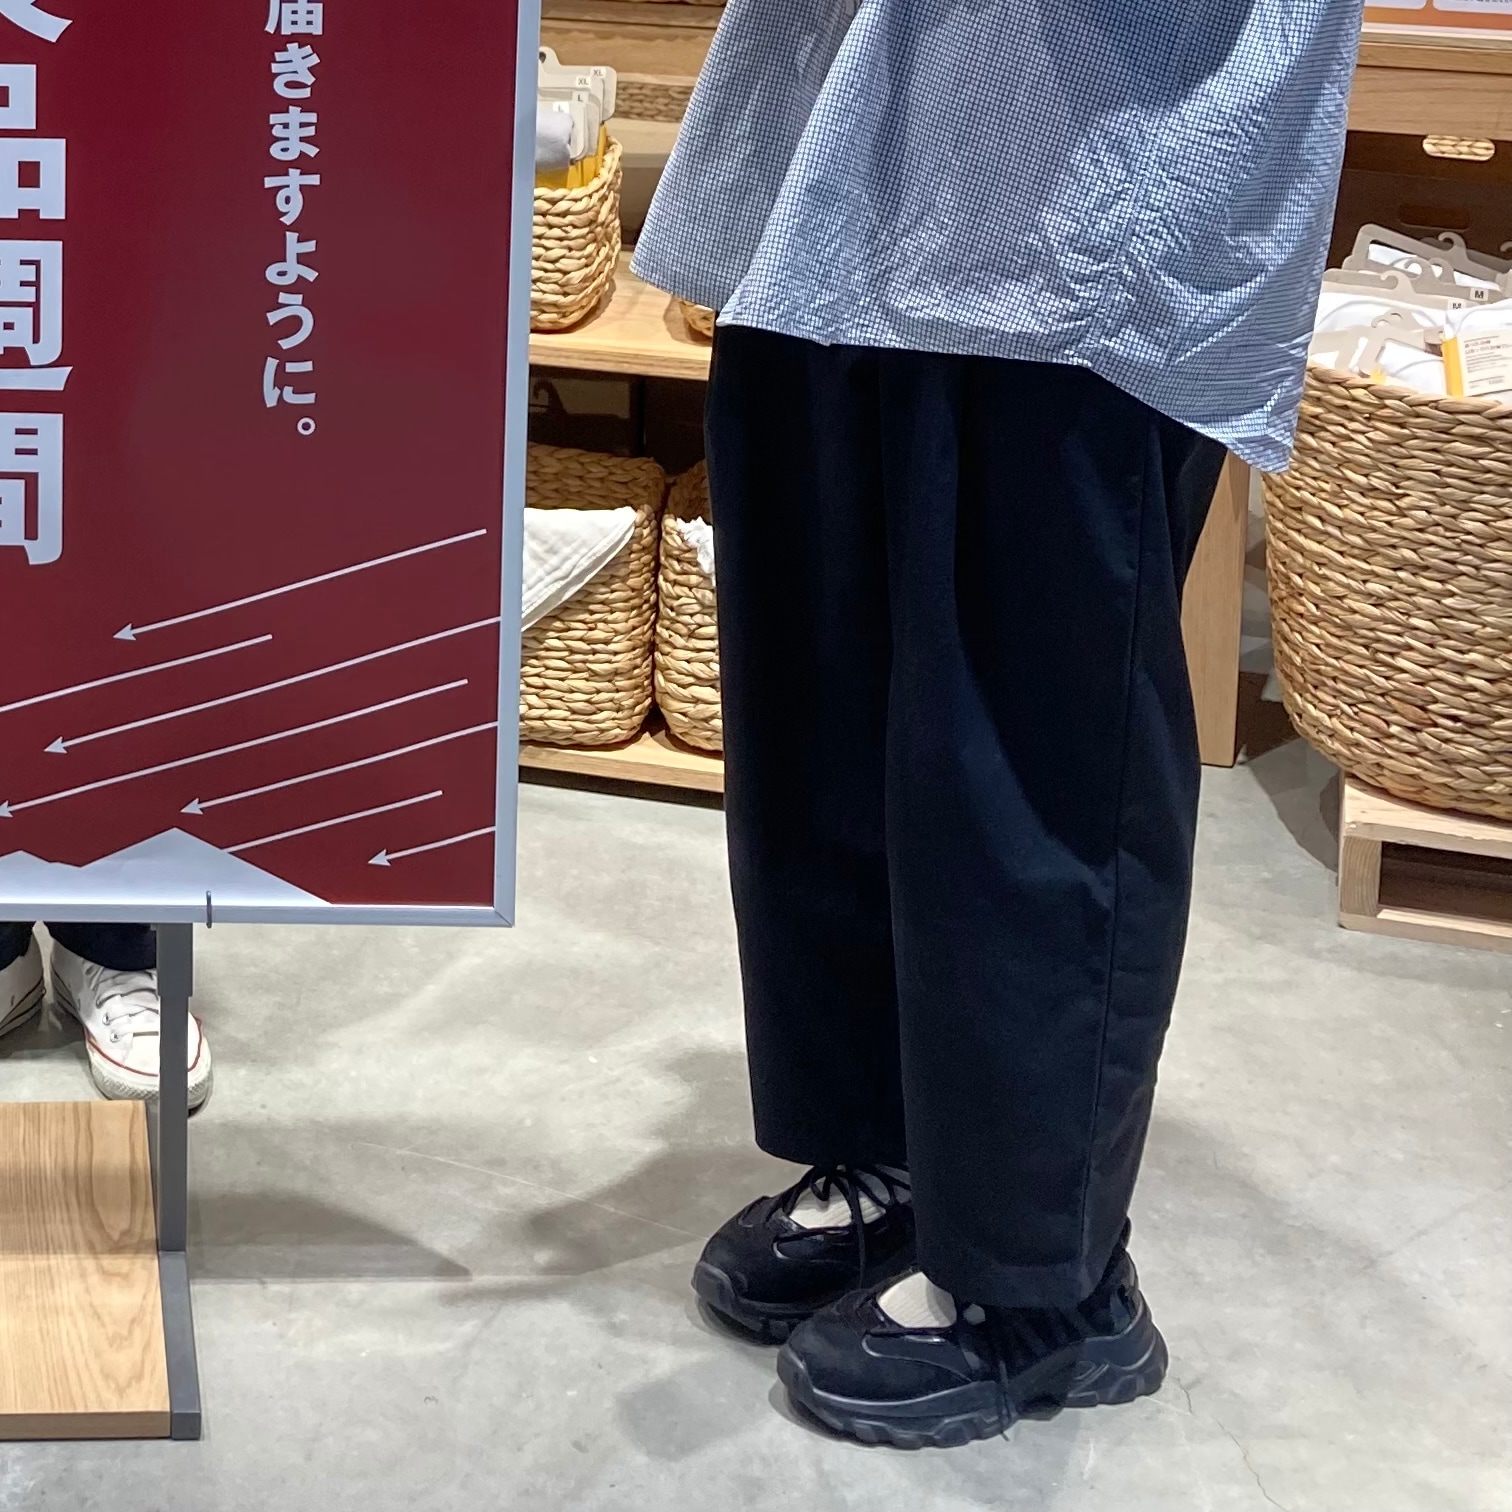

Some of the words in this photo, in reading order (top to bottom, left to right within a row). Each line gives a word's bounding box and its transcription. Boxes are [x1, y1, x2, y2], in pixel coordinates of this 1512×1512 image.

[593, 69, 603, 77] XL
[578, 78, 589, 86] XL
[1475, 290, 1484, 299] M
